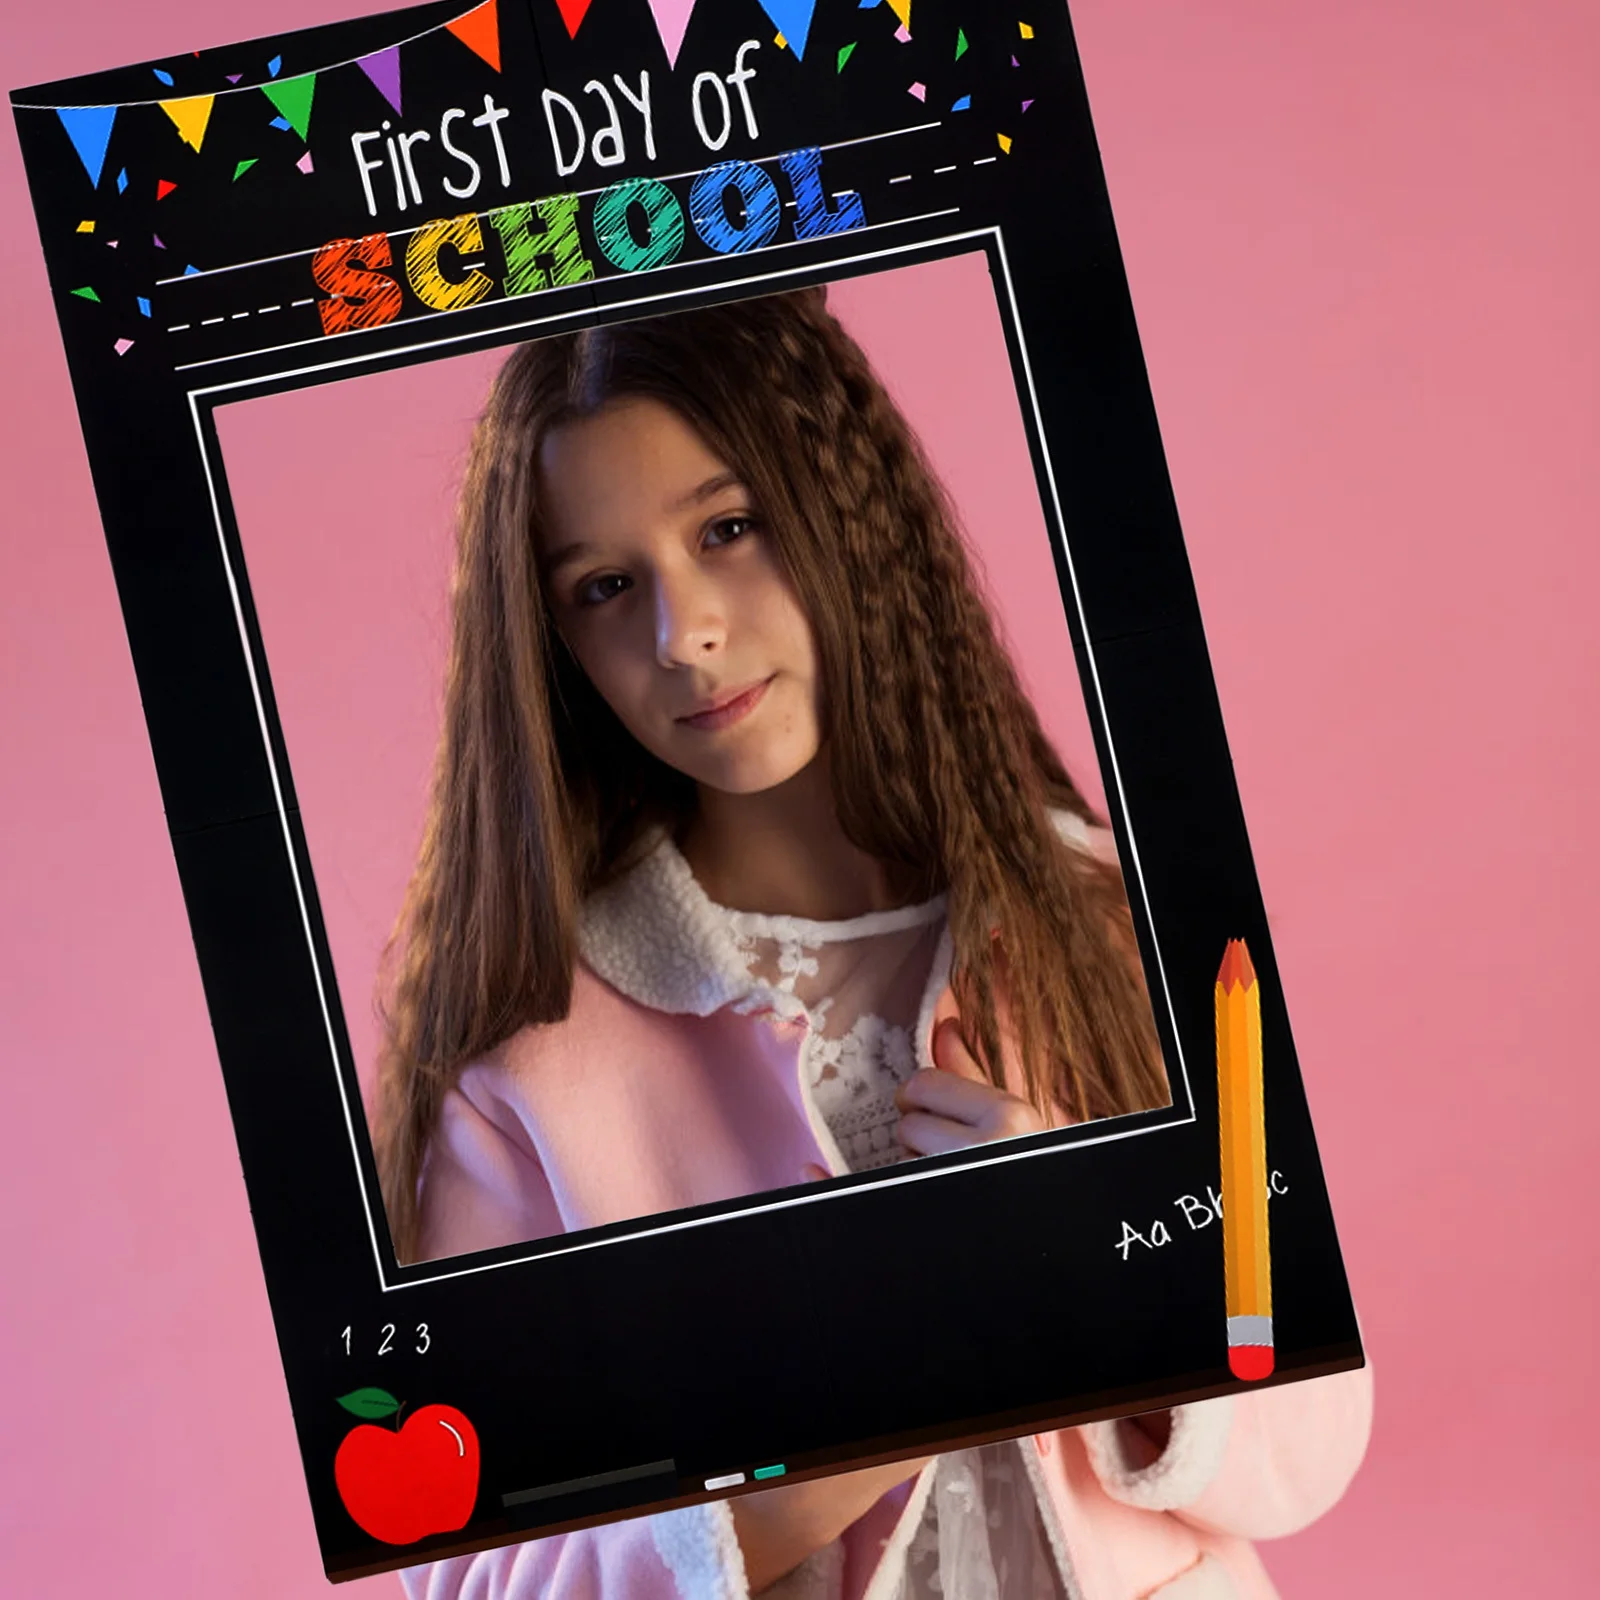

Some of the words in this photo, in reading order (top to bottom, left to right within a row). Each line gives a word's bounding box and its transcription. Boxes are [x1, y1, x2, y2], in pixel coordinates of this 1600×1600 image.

[311, 147, 865, 337] SCHOOL
[1114, 1220, 1172, 1261] Aa
[341, 1325, 352, 1356] 1
[377, 1323, 396, 1356] 2
[415, 1322, 431, 1355] 3
